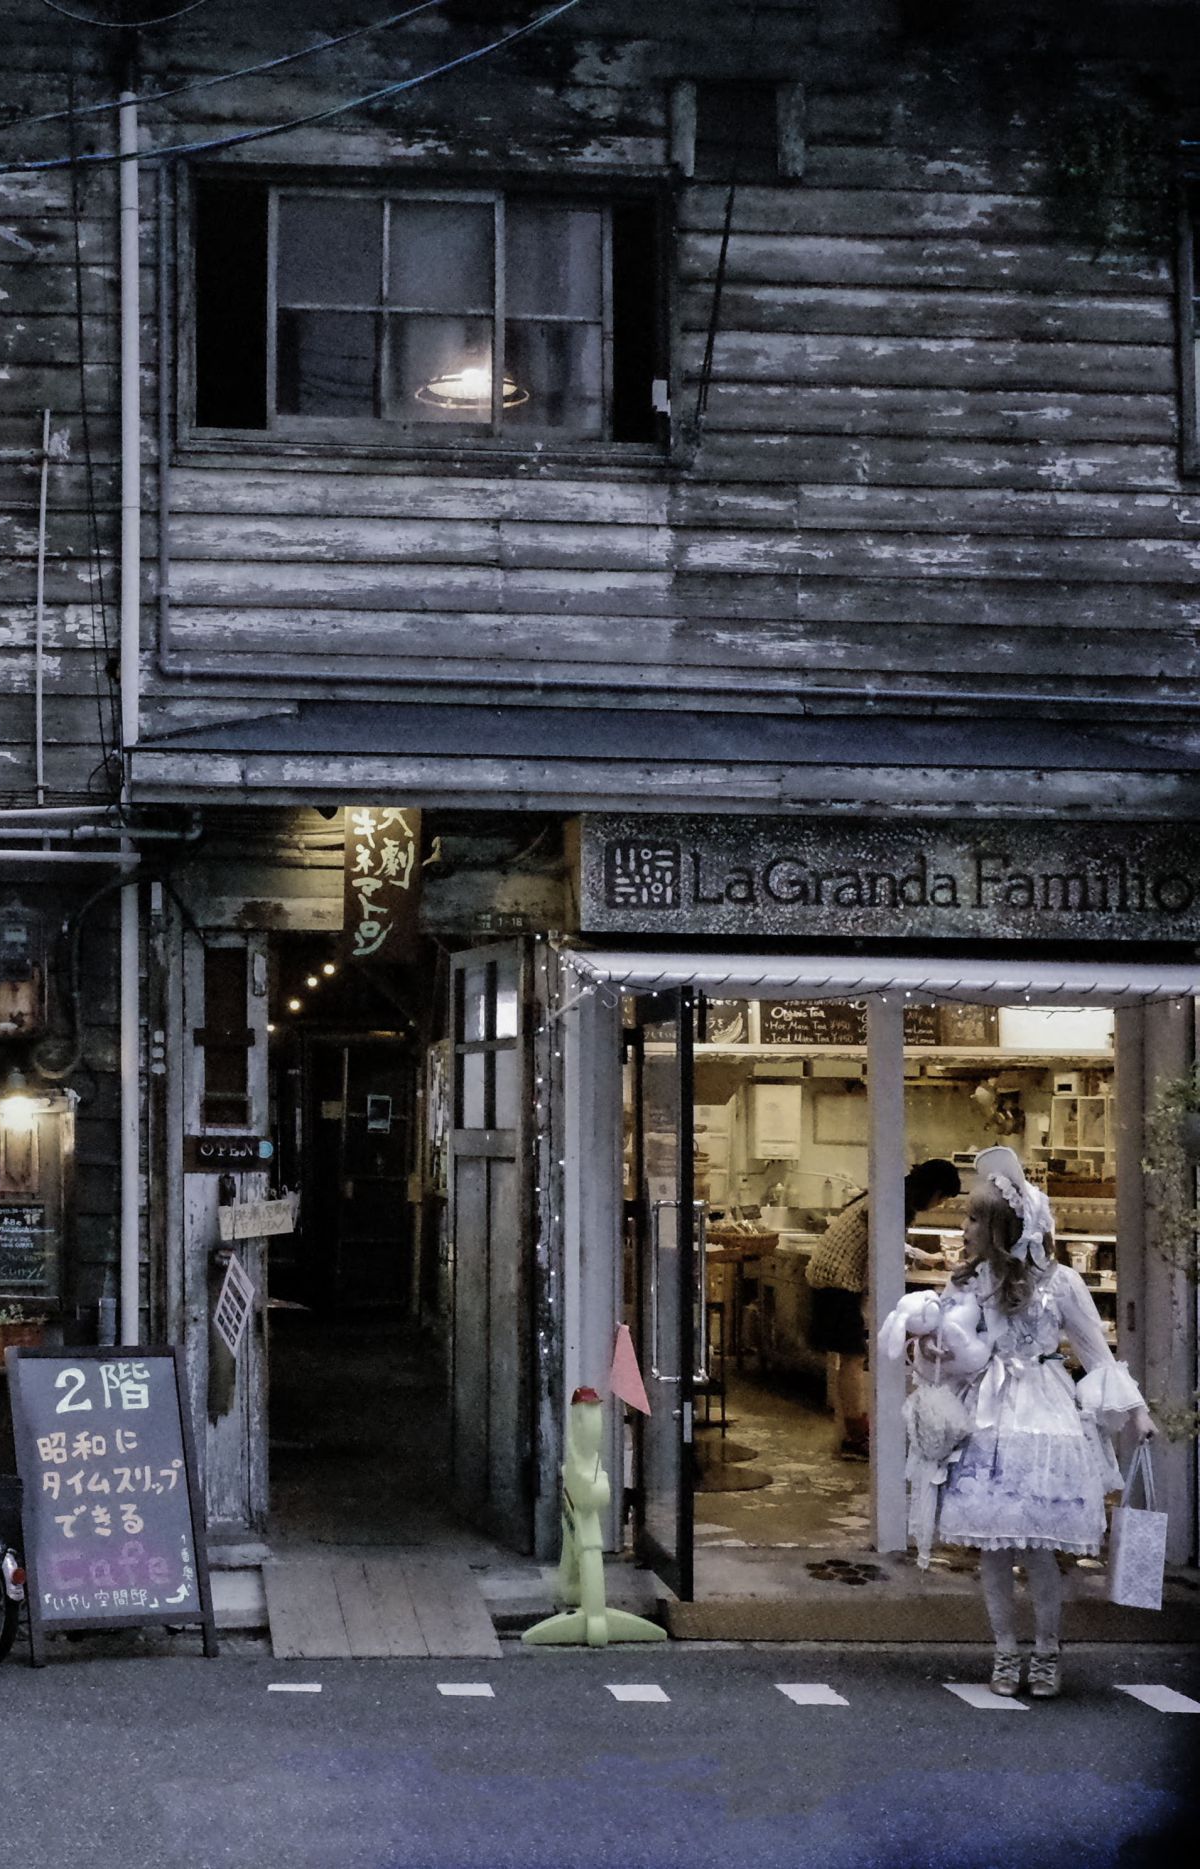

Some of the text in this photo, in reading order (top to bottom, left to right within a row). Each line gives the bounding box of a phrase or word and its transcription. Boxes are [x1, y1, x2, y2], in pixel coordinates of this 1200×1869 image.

[770, 1006, 826, 1021] Organic Tea
[771, 1033, 791, 1043] Iced
[200, 1141, 253, 1157] OPEN
[54, 1361, 150, 1414] 2階
[36, 1428, 138, 1464] 昭和に
[42, 1459, 183, 1500] タイムスリップ
[54, 1503, 145, 1539] できる
